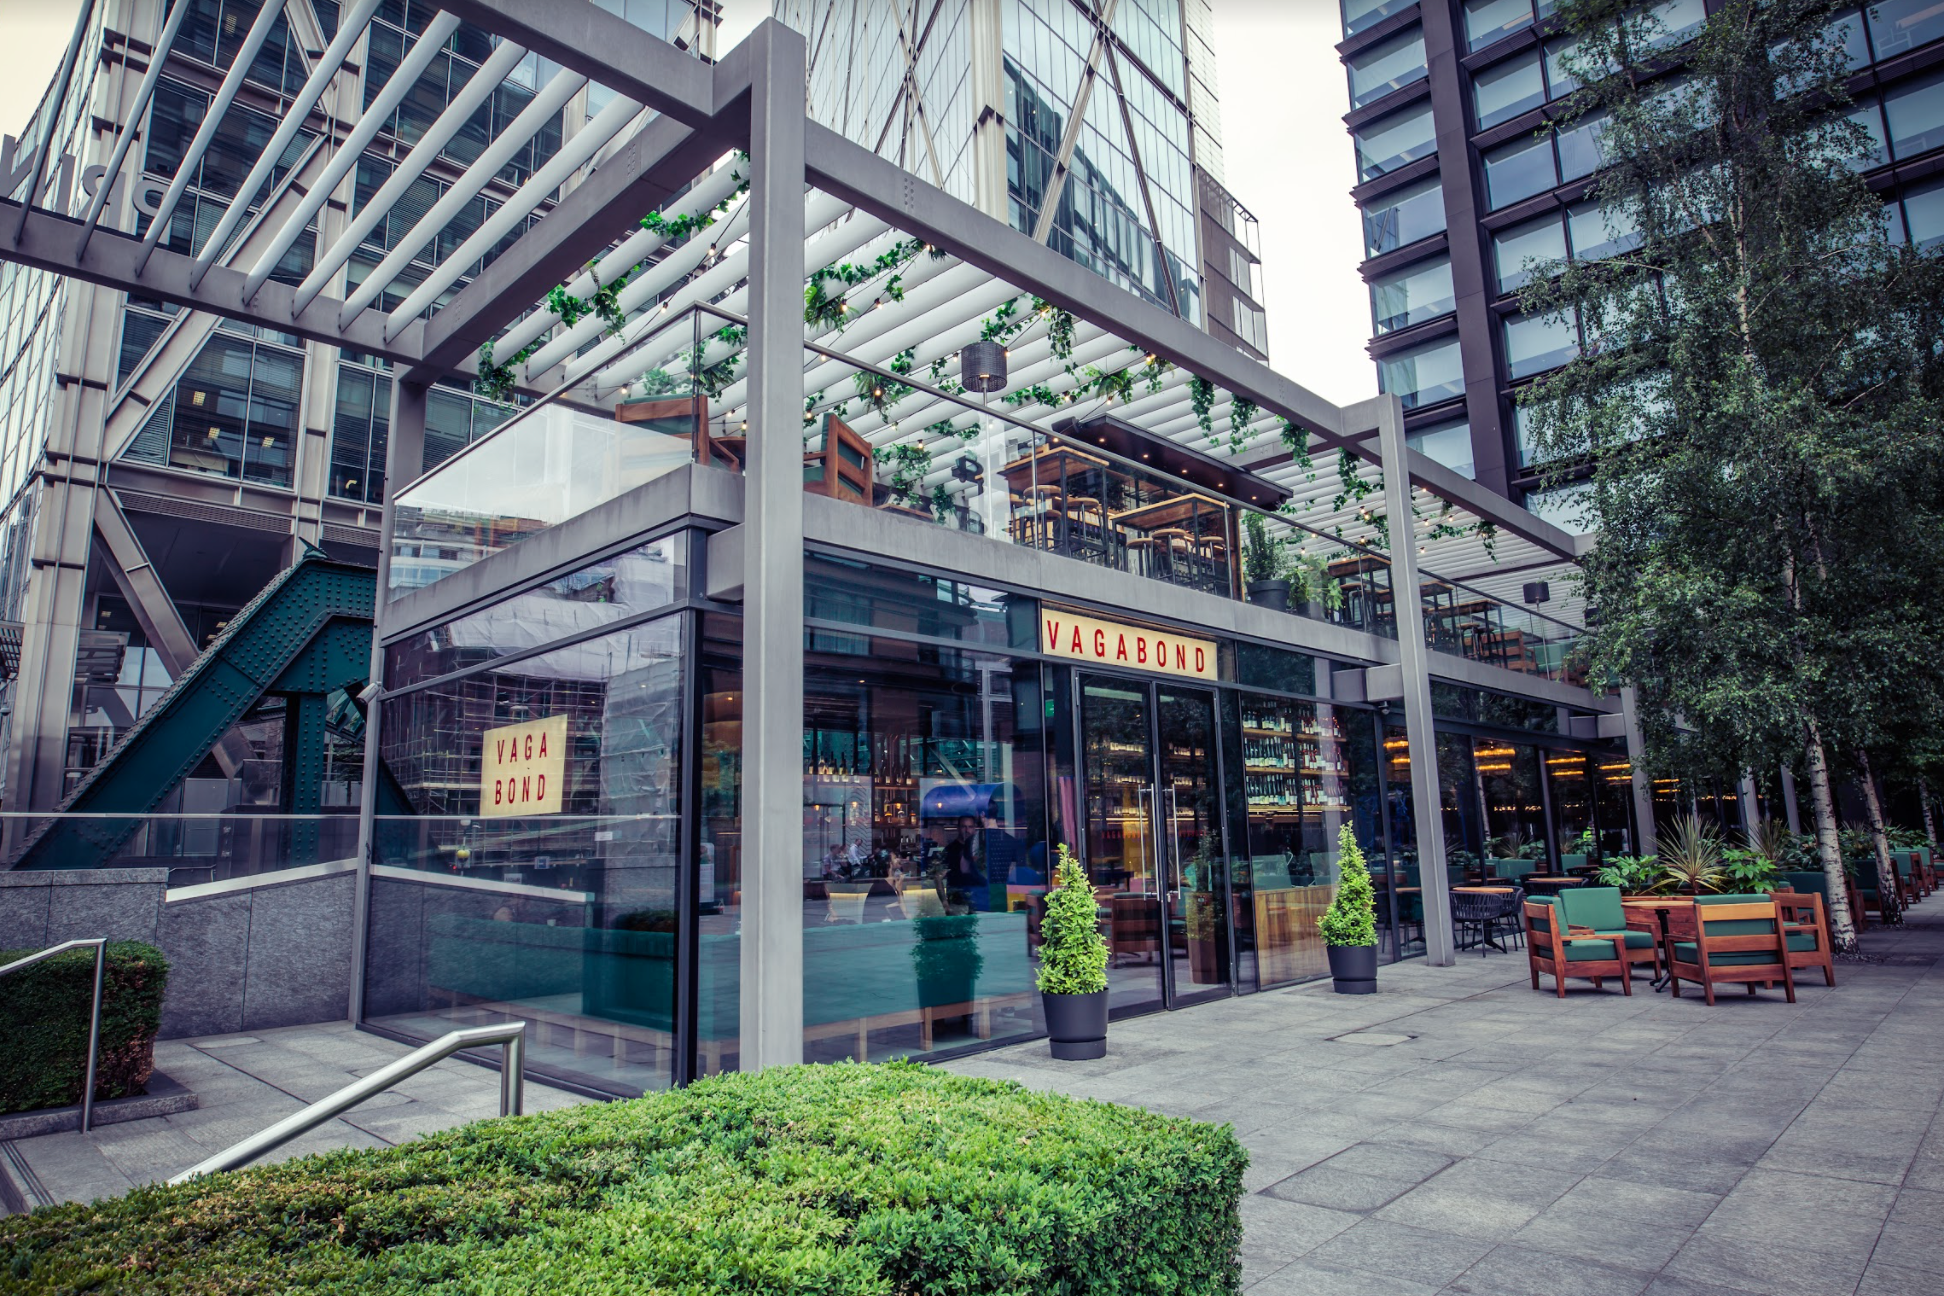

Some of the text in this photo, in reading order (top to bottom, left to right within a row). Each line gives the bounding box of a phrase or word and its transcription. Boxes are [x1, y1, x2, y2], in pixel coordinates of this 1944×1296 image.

[1047, 620, 1205, 672] VAGABOND
[498, 732, 547, 764] VAGA
[495, 774, 546, 805] BOND
